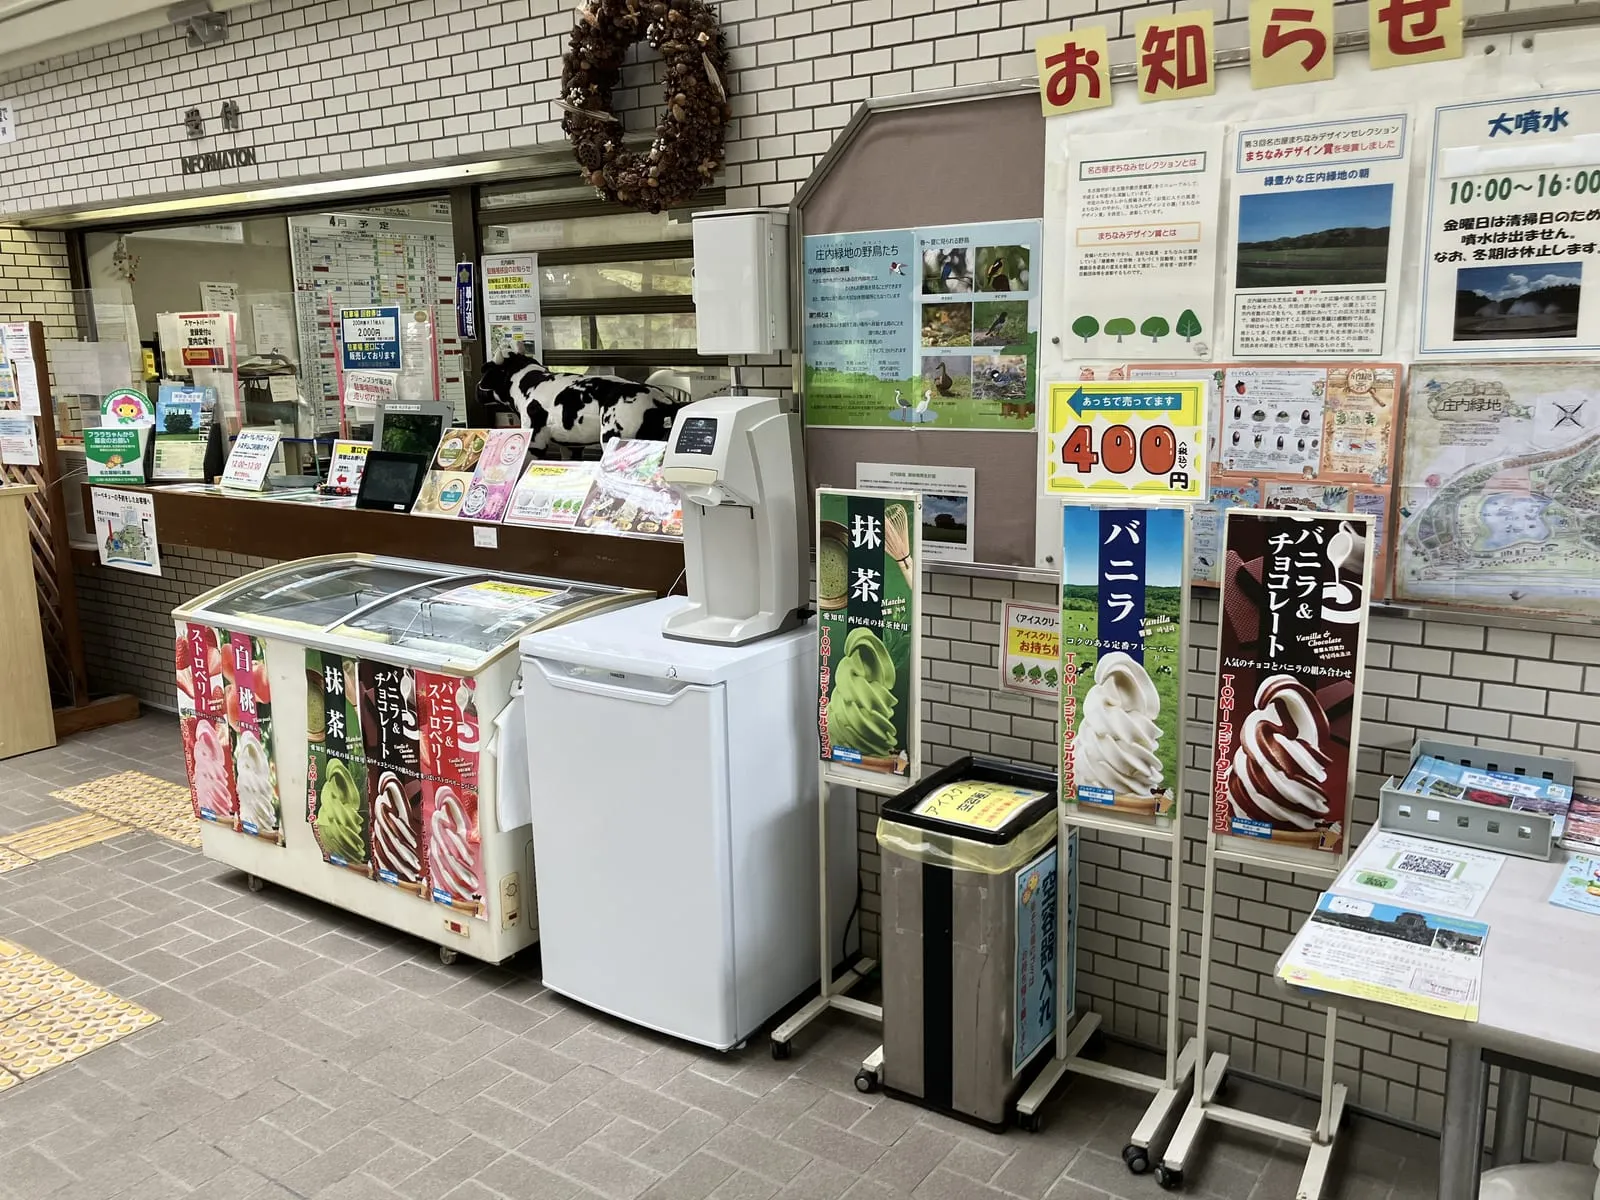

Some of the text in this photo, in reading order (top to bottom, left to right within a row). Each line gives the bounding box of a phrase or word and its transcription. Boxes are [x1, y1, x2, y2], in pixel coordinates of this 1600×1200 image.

[1488, 107, 1569, 138] 大噴水
[181, 147, 256, 174] INFORMATION
[1098, 229, 1177, 241] まちなみデザイン賞とは
[1443, 210, 1600, 232] 金曜日は清掃日のため
[1461, 228, 1576, 247] 噴水は出ません。
[815, 245, 899, 261] 庄内緑地の野鳥たち
[1083, 396, 1175, 408] あっちで売ってます
[1442, 398, 1502, 412] 庄内緑地
[1061, 424, 1189, 490] 400 円
[851, 513, 882, 603] 抹茶
[1104, 518, 1141, 624] バニラ
[1294, 525, 1325, 620] バニラ&
[880, 596, 906, 608] Matcha
[1267, 531, 1294, 659] チョコレート
[1139, 614, 1171, 627] Vanilla
[1066, 637, 1175, 653] コクのある定番フレーバー
[1296, 632, 1322, 642] Vanilla
[1307, 637, 1342, 648] Chocolate
[191, 629, 208, 711] ストロベリー
[235, 645, 256, 714] 白桃
[1223, 656, 1353, 679] 人気のチョコとバニラの組み合わせ
[325, 665, 345, 739] 抹茶
[374, 671, 390, 760] チョコレート
[385, 670, 401, 735] バニラ&
[439, 680, 455, 748] バニラ&
[427, 683, 443, 775] ストロベリー
